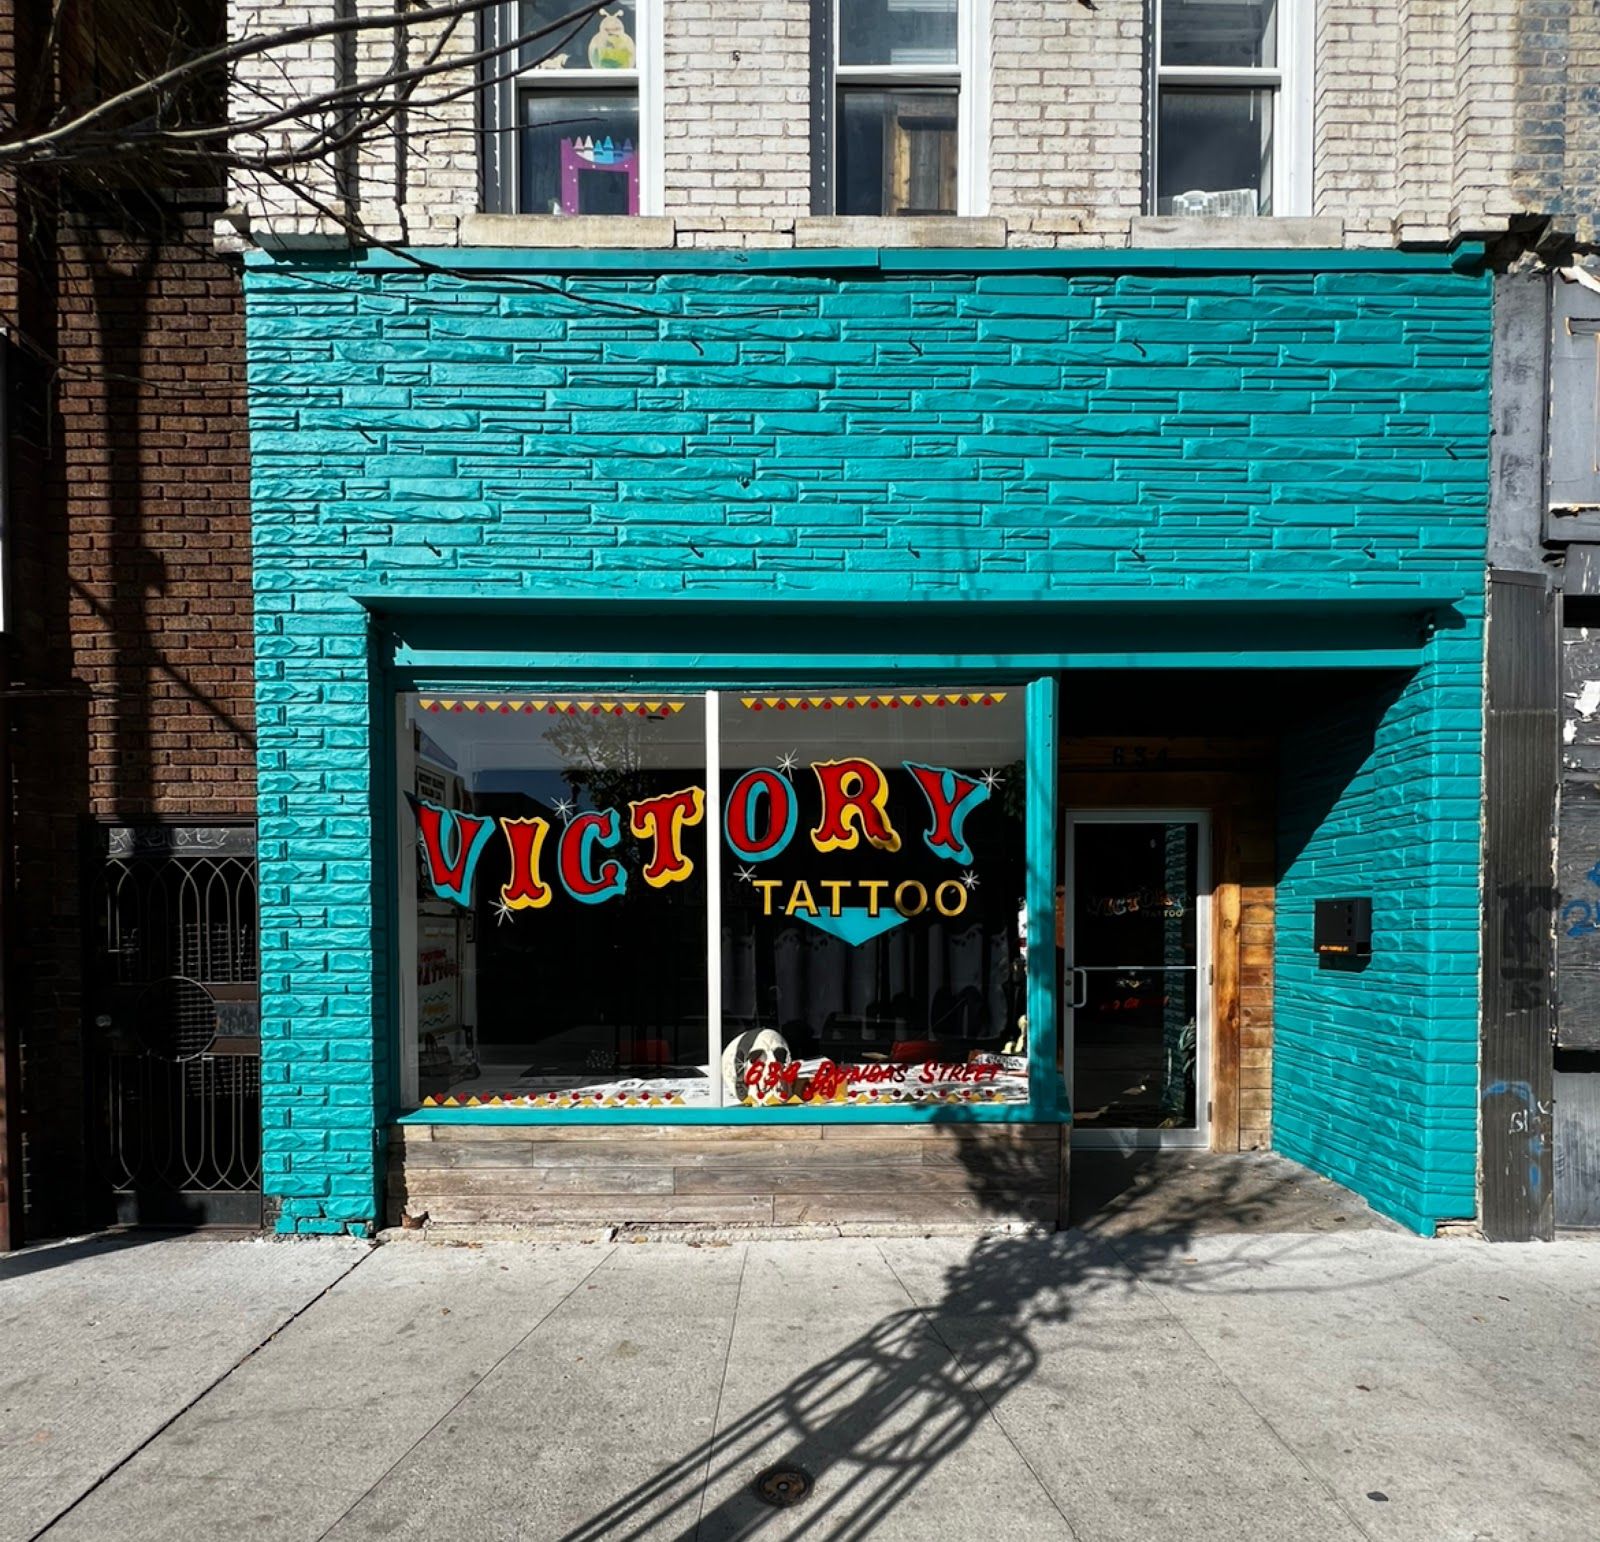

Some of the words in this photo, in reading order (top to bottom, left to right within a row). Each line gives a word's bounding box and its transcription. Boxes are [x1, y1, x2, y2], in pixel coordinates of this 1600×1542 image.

[403, 757, 991, 908] VICTORY
[752, 880, 968, 917] TATTOO
[813, 1060, 909, 1088] DUNDAS
[919, 1057, 1004, 1084] STREET
